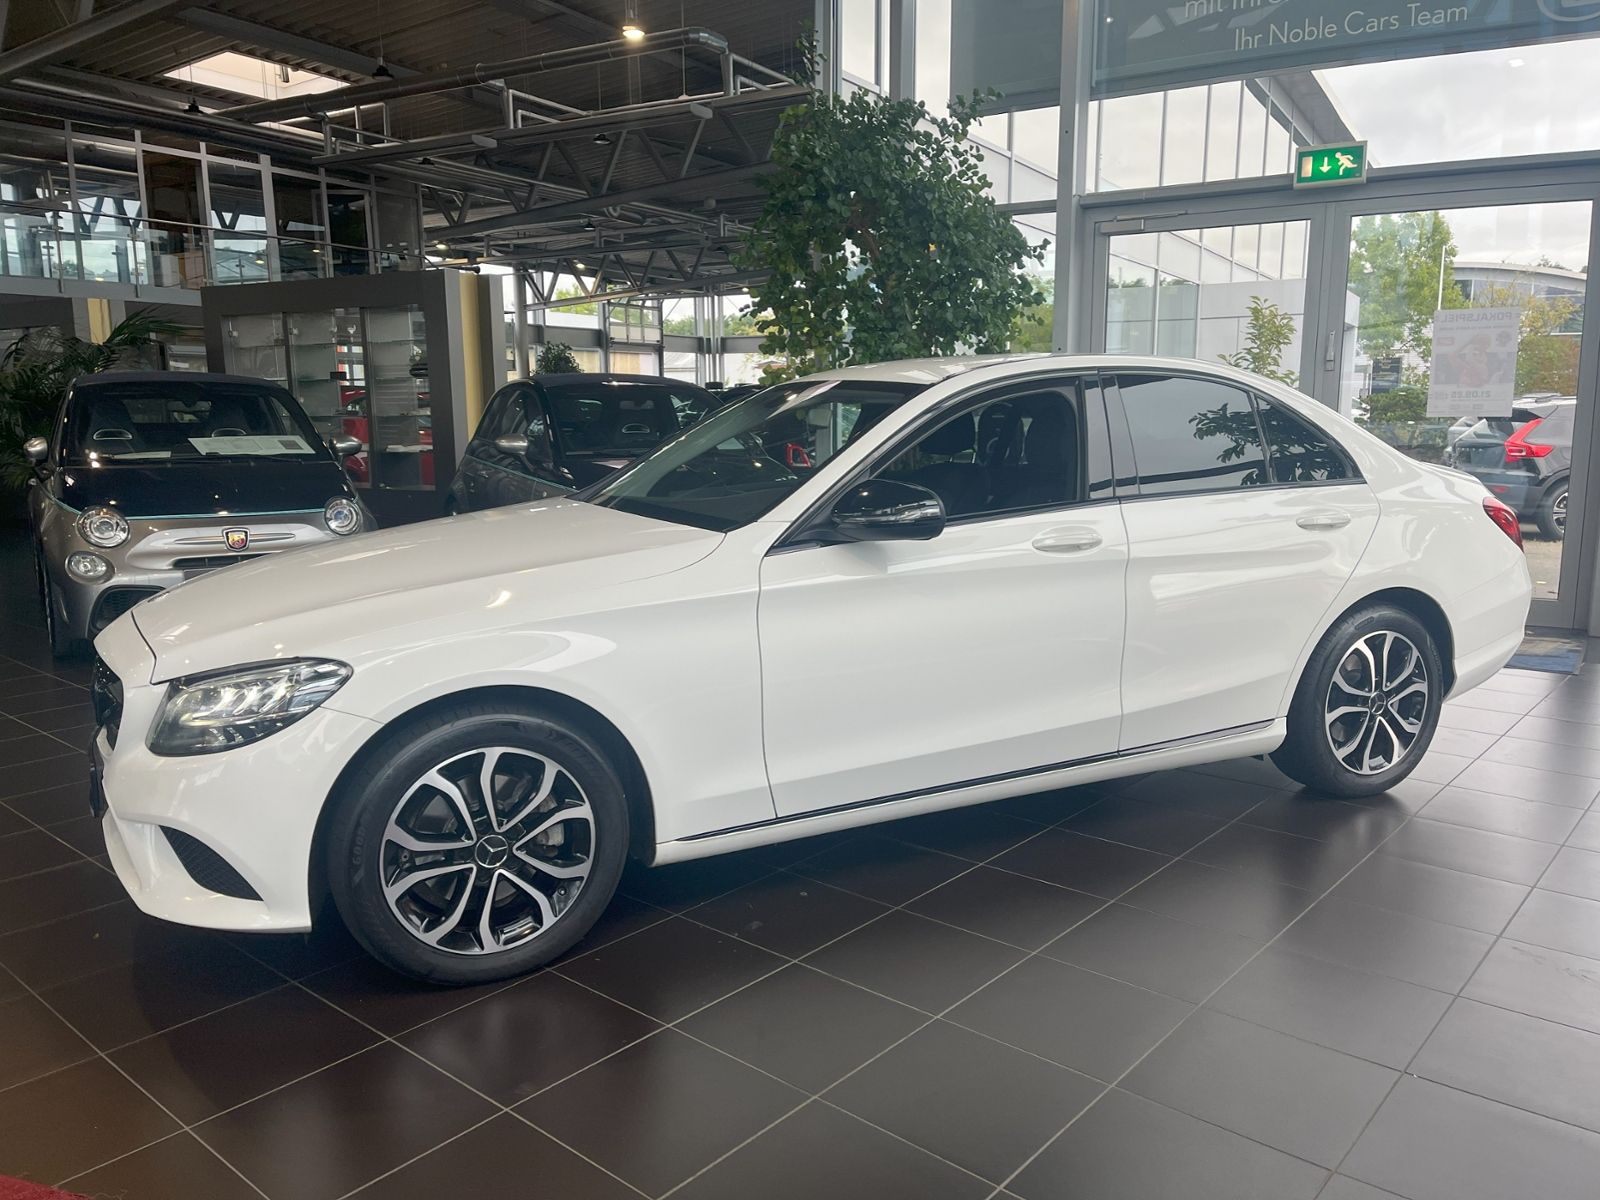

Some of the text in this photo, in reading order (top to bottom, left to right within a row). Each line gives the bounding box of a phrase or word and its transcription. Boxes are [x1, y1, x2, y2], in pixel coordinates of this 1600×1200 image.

[1234, 3, 1468, 51] Ihr Noble Cars Team
